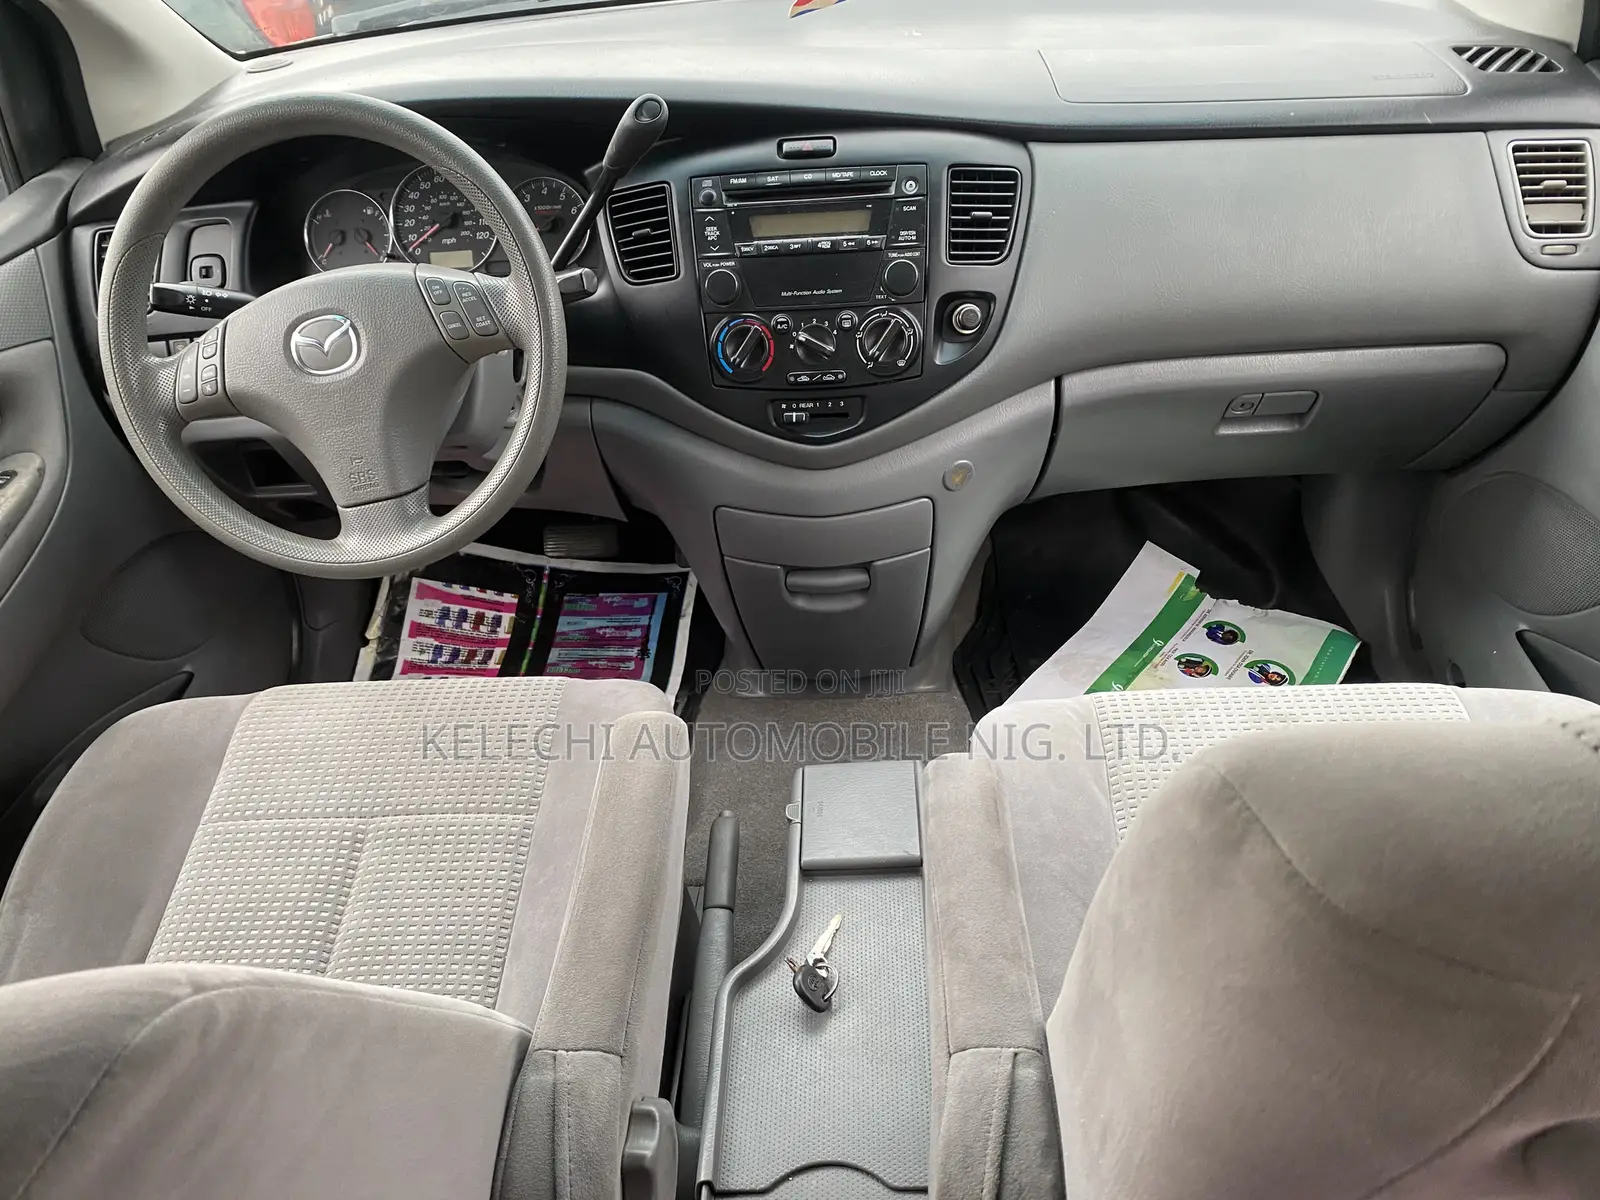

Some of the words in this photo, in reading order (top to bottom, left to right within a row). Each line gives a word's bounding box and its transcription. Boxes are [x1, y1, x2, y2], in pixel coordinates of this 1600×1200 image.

[541, 187, 548, 195] 4
[524, 194, 531, 203] 3
[560, 192, 566, 200] 5
[571, 206, 578, 215] 6
[475, 232, 490, 240] 120
[442, 237, 457, 245] mph
[475, 320, 491, 328] COAST
